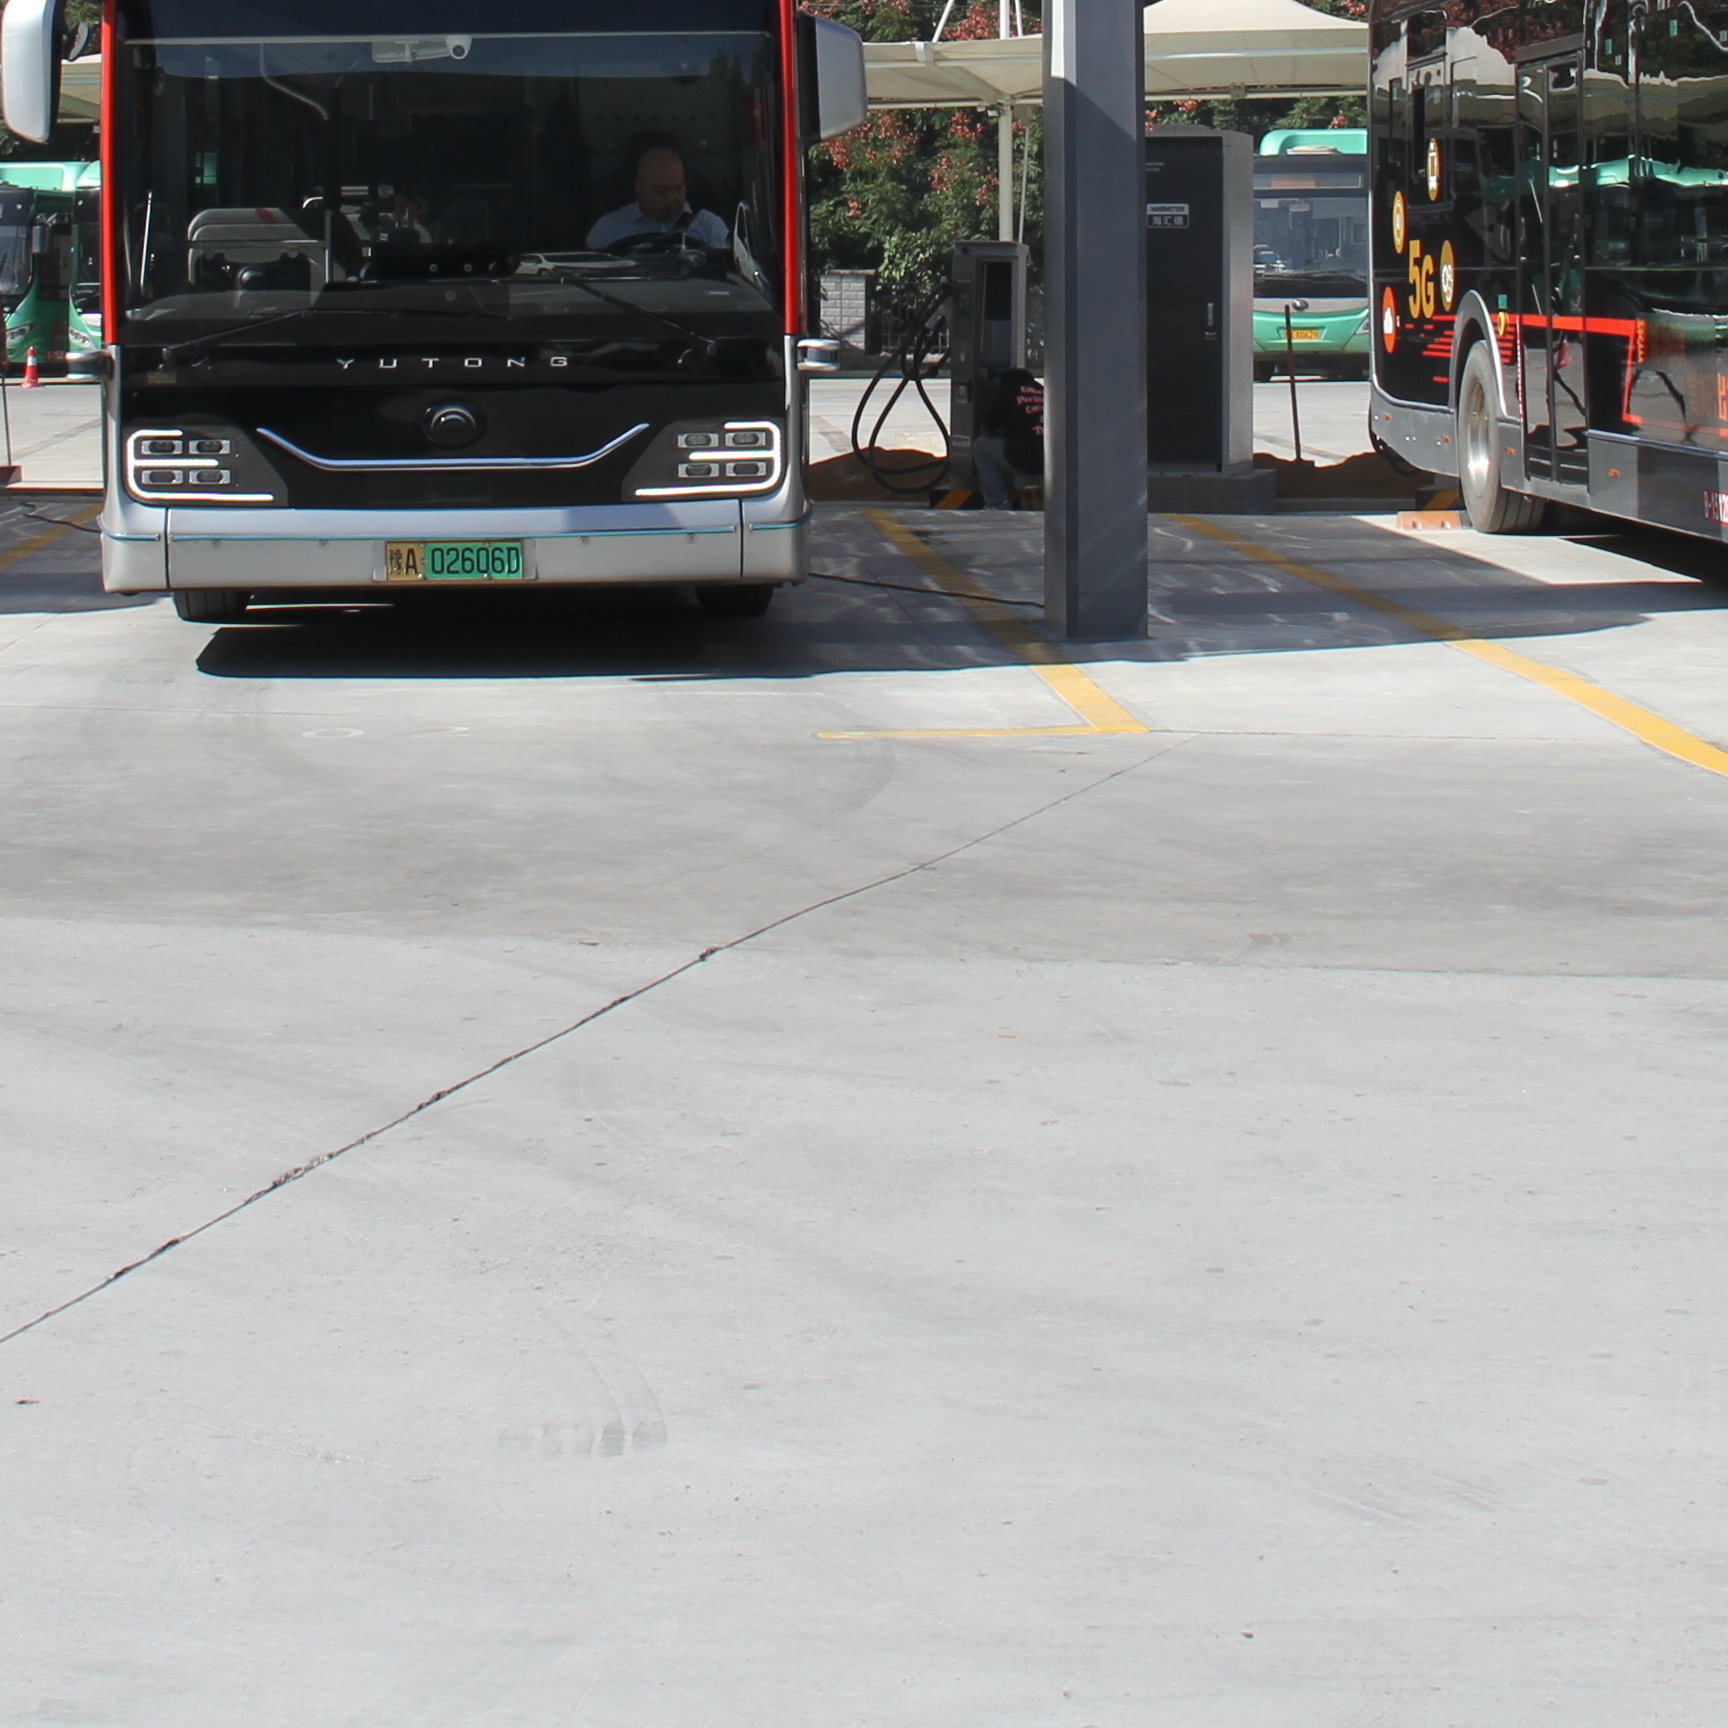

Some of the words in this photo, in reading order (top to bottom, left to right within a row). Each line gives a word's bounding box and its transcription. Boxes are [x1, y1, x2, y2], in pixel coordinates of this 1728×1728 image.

[1409, 240, 1435, 319] 5G
[336, 356, 569, 370] YUTONG
[389, 547, 418, 575] 豫A
[430, 546, 520, 575] 02606D
